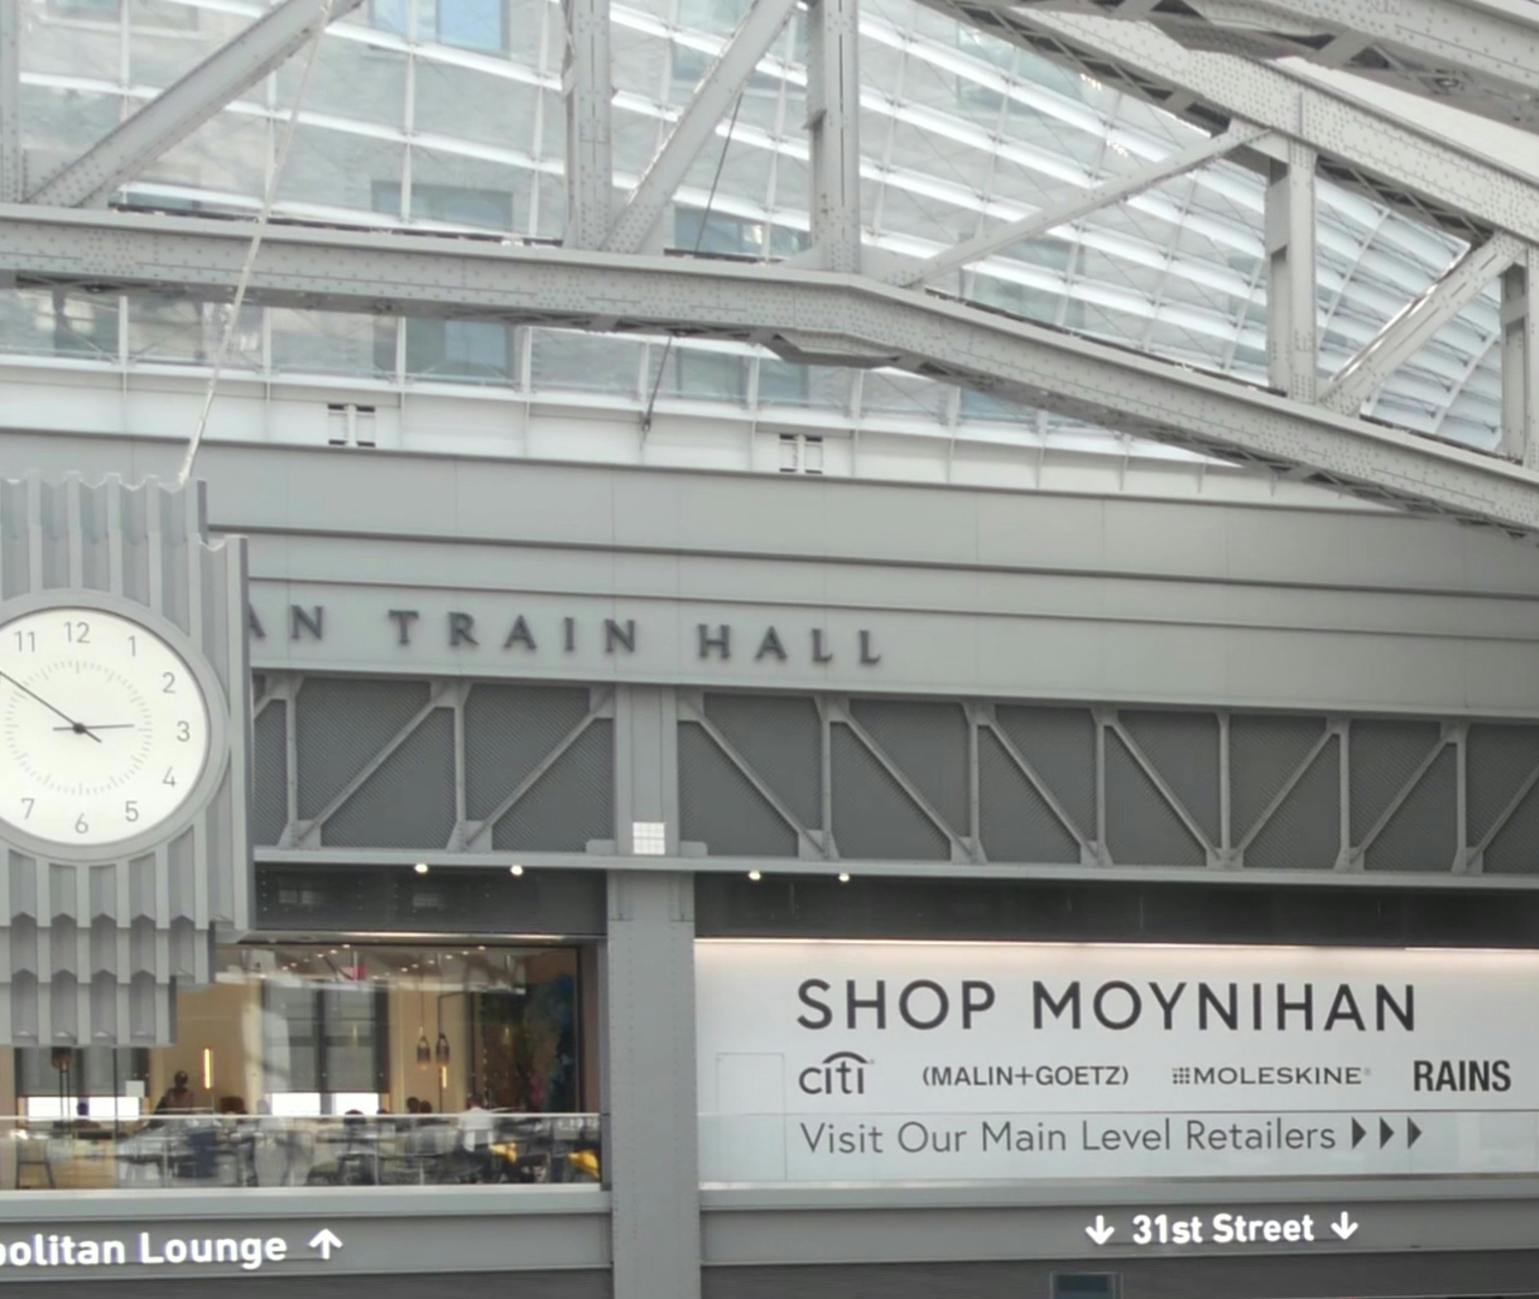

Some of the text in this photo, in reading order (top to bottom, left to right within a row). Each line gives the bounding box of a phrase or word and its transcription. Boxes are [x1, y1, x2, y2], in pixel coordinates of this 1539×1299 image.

[15, 631, 35, 651] 11
[65, 622, 89, 643] 12
[389, 610, 635, 654] TRAIN
[698, 625, 880, 666] HALL
[129, 636, 135, 656] 1
[163, 672, 175, 693] 2
[177, 721, 190, 742] 3
[163, 767, 176, 786] 4
[21, 798, 34, 819] 7
[126, 801, 139, 822] 5
[75, 814, 88, 834] 6
[798, 979, 1414, 1031] SHOP MOYNIHAN
[800, 1052, 867, 1095] citi
[923, 1066, 1128, 1085] (MALIN+GOETZ)
[1415, 1061, 1510, 1091] RAINS
[801, 1118, 1335, 1153] Visit Our Main Level Retailers
[1134, 1214, 1314, 1243] 31st Street
[141, 1233, 286, 1269] Lounge
